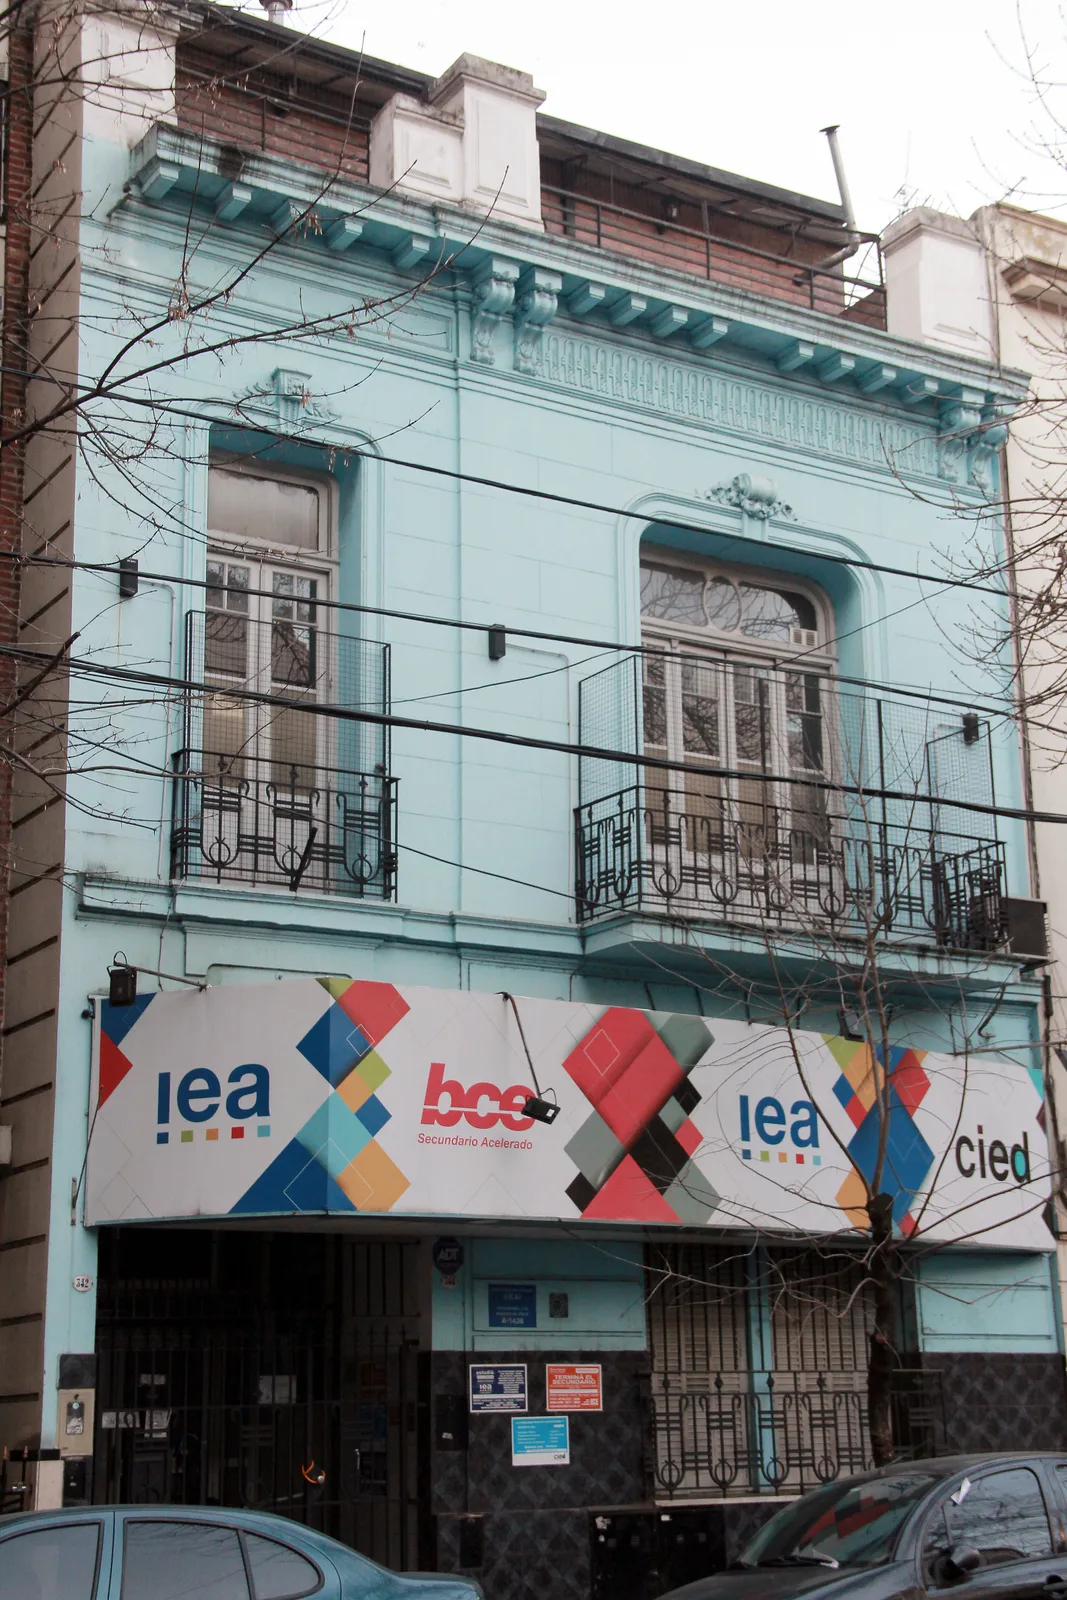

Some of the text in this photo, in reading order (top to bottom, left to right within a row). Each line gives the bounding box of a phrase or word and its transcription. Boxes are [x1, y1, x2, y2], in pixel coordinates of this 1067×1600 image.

[417, 1132, 533, 1150] Secundario Acelerado
[955, 1124, 1031, 1183] cied
[437, 1247, 459, 1260] ADT
